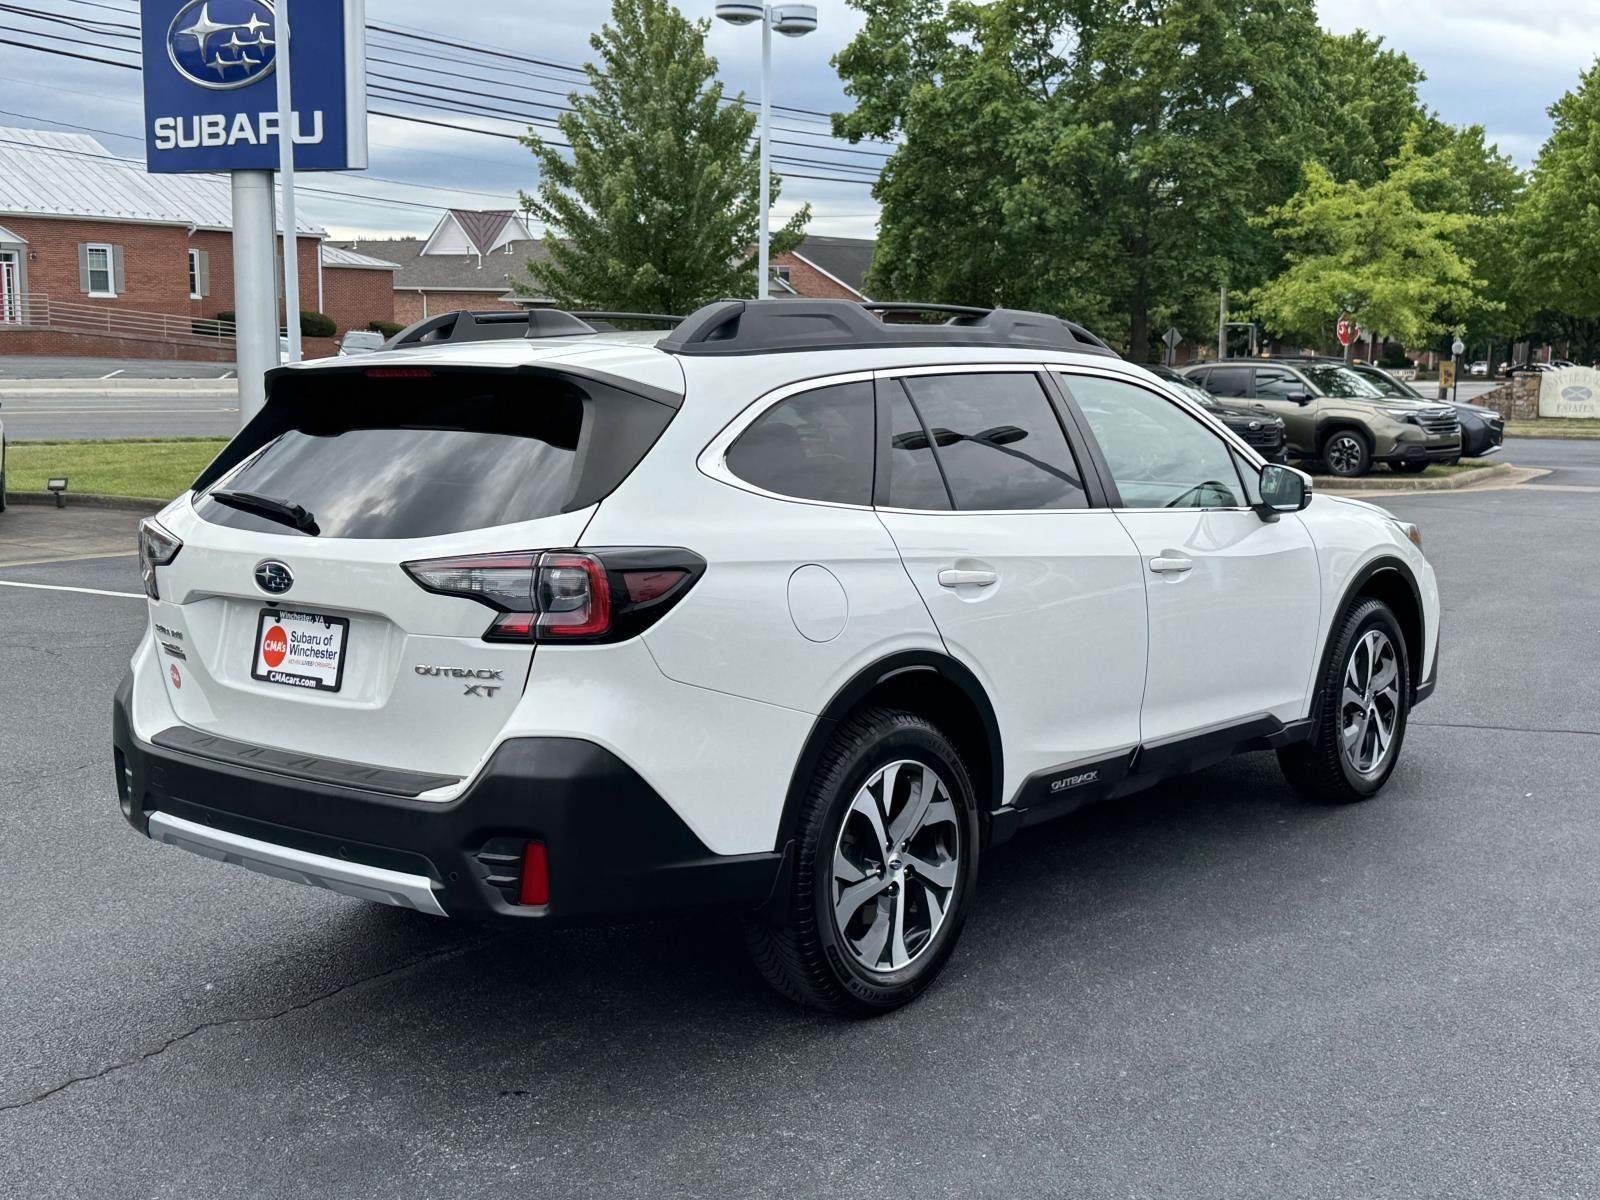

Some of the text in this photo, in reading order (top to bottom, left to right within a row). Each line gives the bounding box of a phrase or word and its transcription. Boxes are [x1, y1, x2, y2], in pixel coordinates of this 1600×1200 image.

[154, 110, 324, 150] SUBARU
[279, 611, 315, 624] Winchester,
[264, 640, 287, 653] CMA's
[290, 630, 333, 647] Subaru of
[289, 643, 338, 661] Winchester
[269, 671, 317, 688] CMAcars.com
[414, 664, 505, 681] OUTBACK
[463, 684, 501, 698] XT
[1050, 770, 1098, 791] OUTBACK
